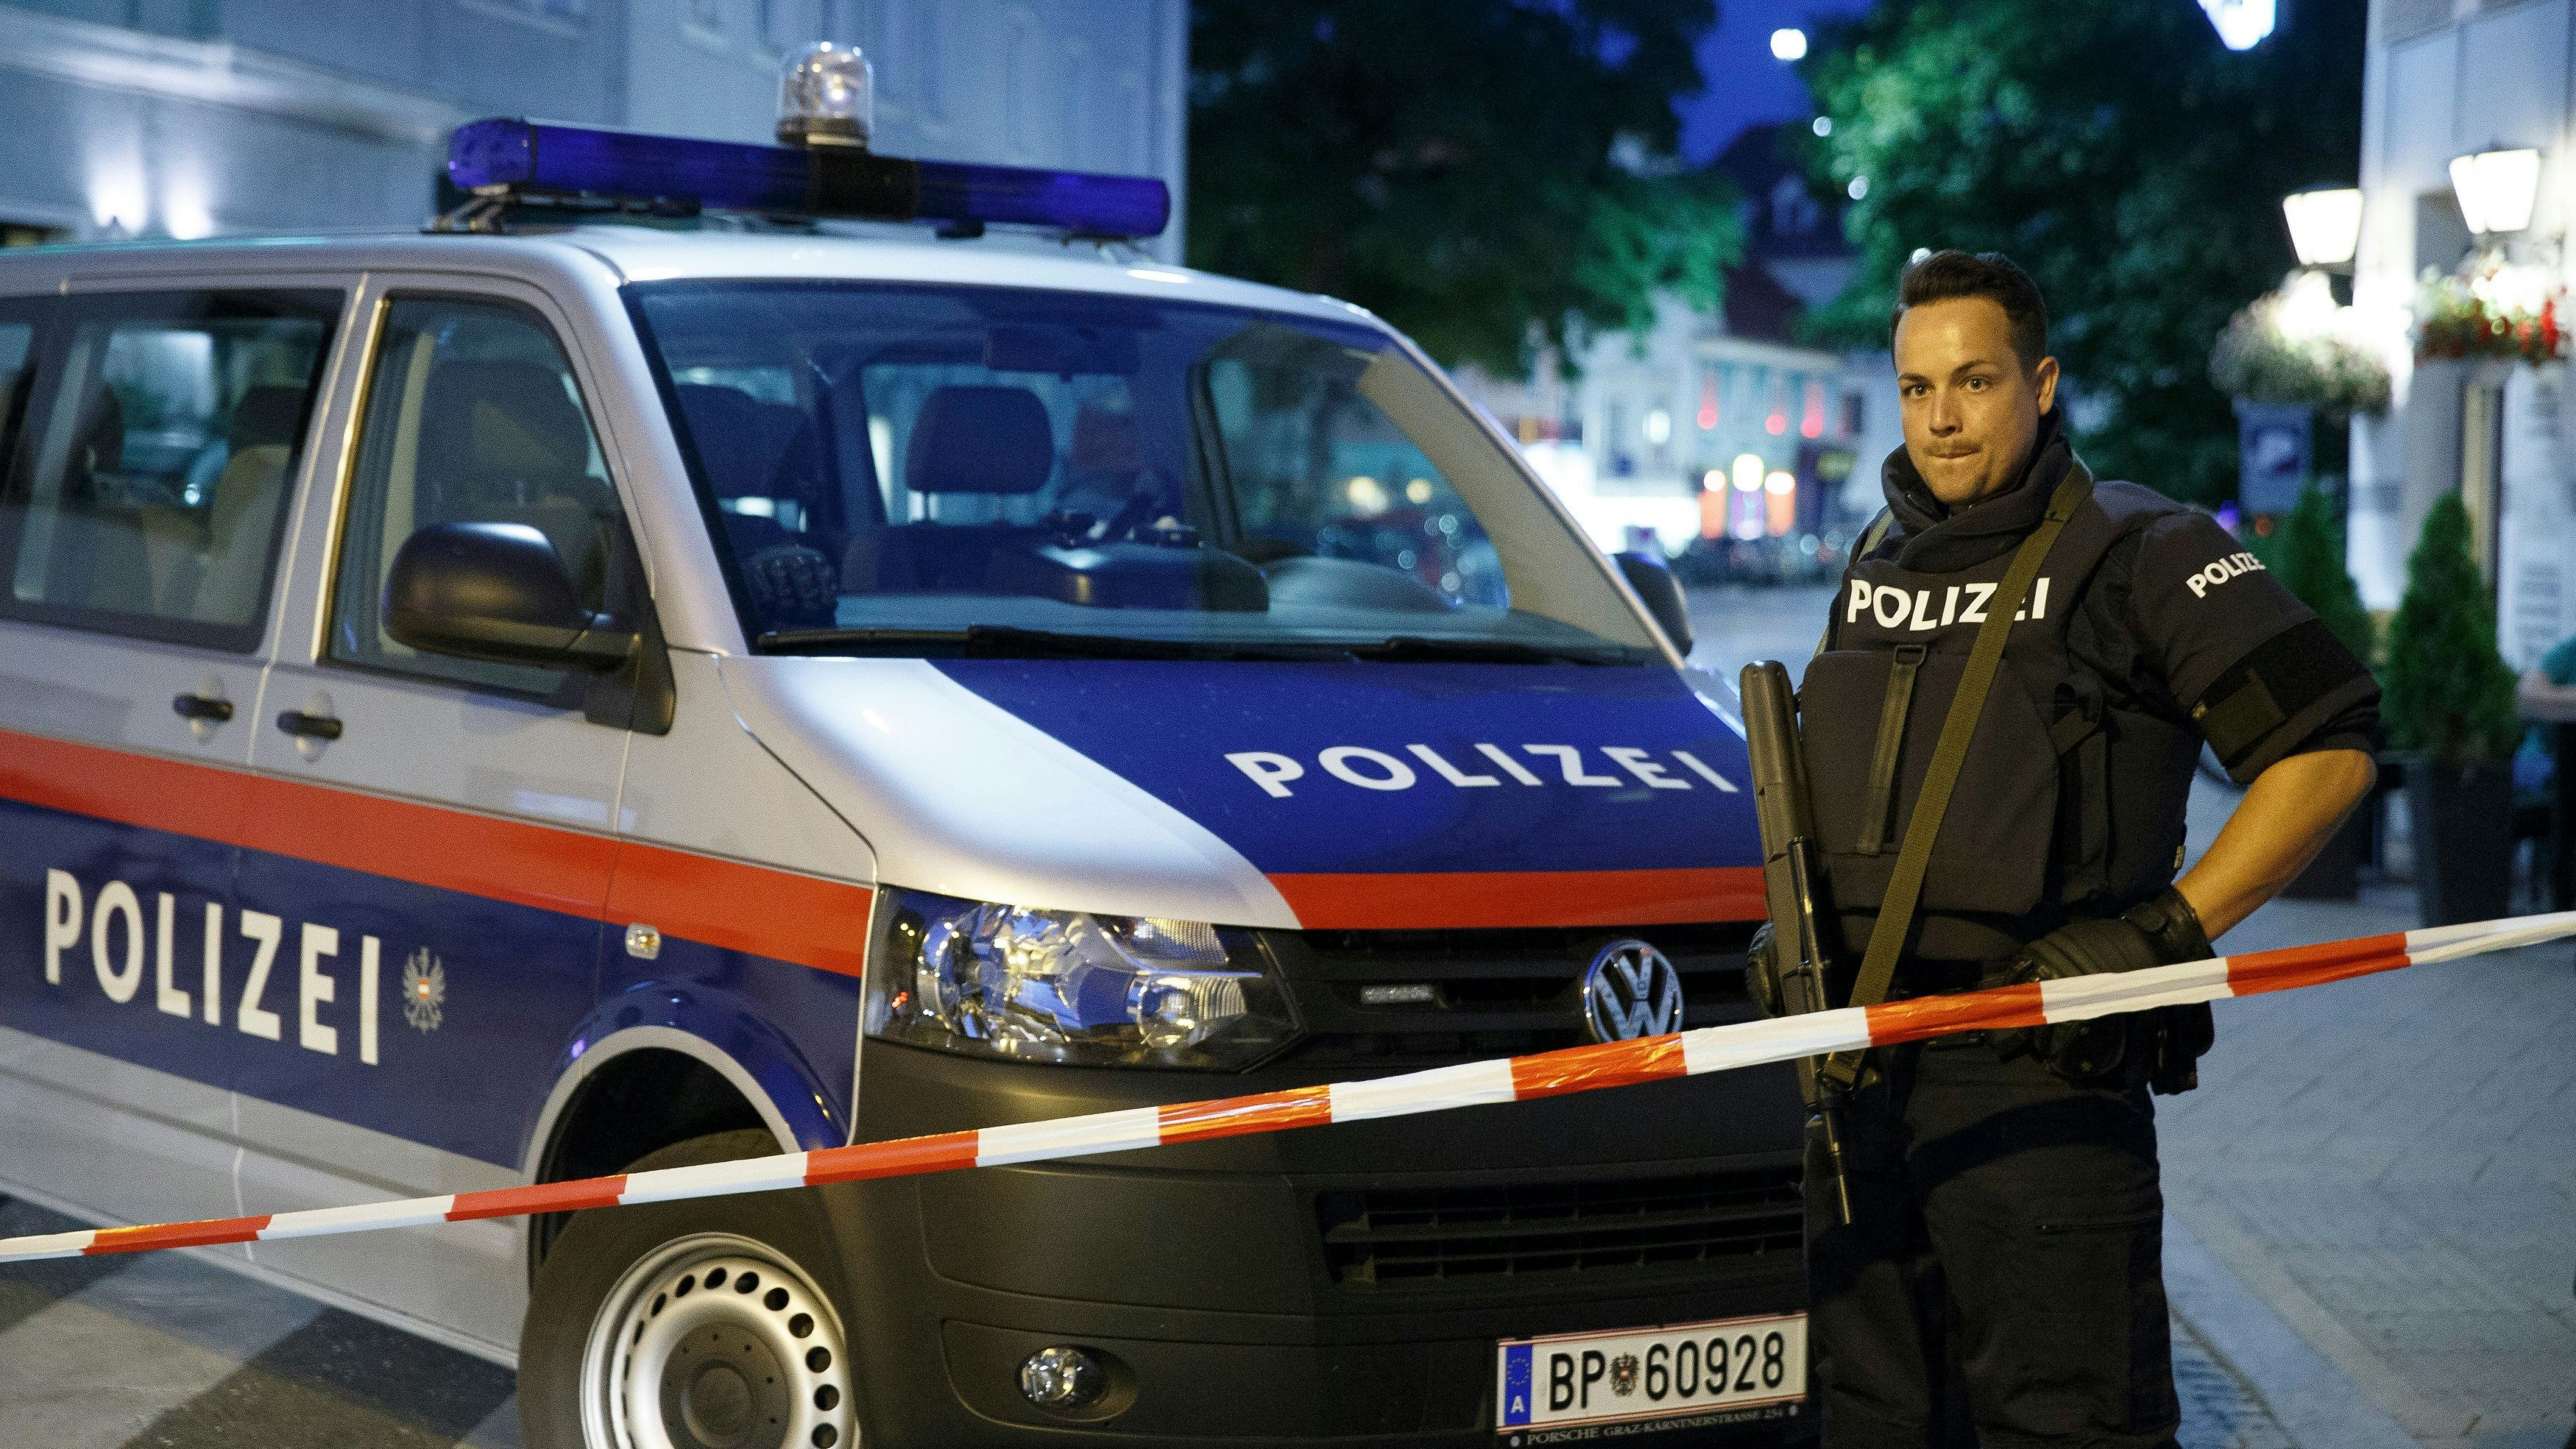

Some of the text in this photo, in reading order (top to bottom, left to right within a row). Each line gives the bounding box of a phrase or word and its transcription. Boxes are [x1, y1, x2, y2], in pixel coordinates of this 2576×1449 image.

[1847, 578, 2050, 631] POLIZI
[1224, 743, 1738, 798] POLIZEI
[45, 868, 380, 1066] POLIZEI
[1585, 939, 1684, 1042] VW
[1549, 1331, 1784, 1411] BP 60928
[1511, 1395, 1524, 1413] A
[1526, 1426, 1599, 1446] PORSCHE
